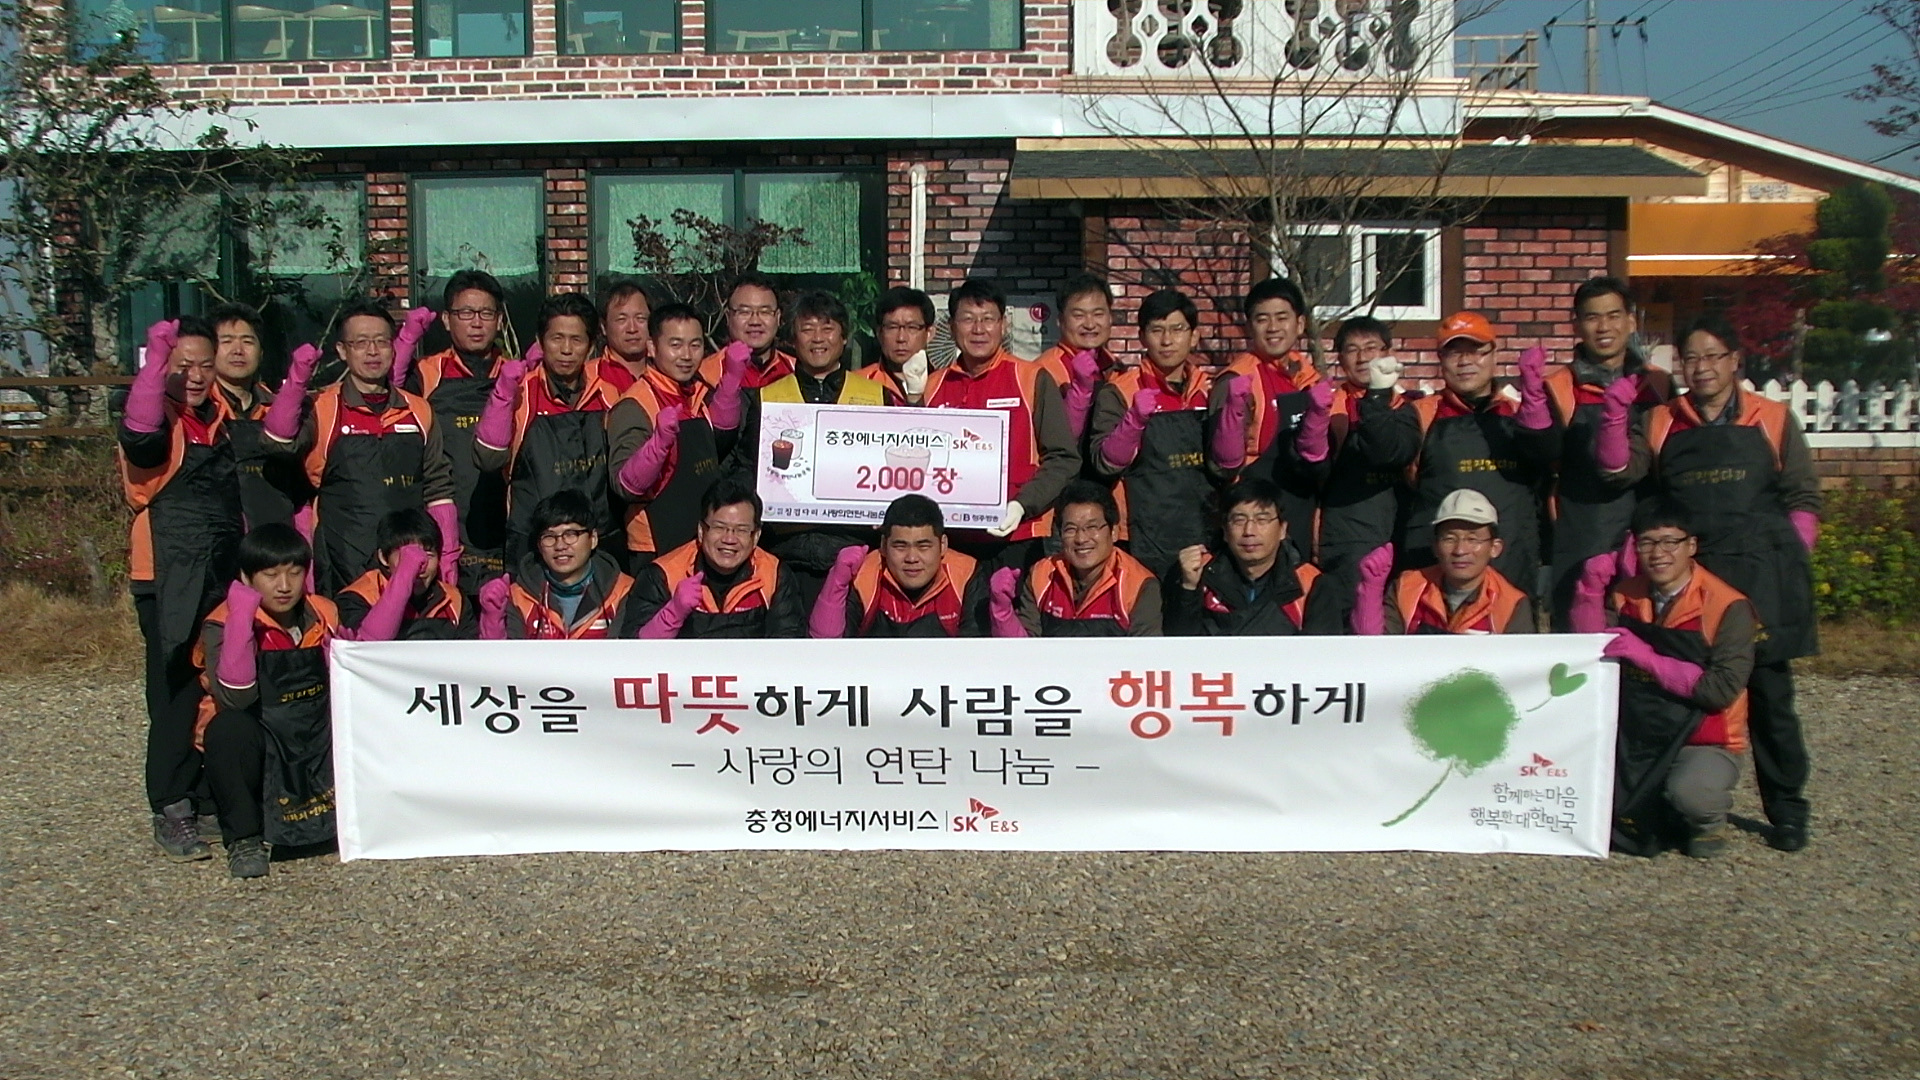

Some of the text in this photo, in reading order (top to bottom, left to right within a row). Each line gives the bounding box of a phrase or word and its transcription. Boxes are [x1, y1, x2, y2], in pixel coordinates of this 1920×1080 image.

[825, 430, 944, 448] 충청에너지서비스
[952, 437, 994, 452] SK E&S
[856, 465, 959, 495] 2,000 장
[406, 670, 1366, 739] 세상을 따뜻하게 사람을 행복하게
[717, 746, 1055, 786] 사랑의 연탄 나눔
[1520, 765, 1568, 778] SK E&S
[746, 809, 939, 834] 충청에너지서비스
[953, 815, 1019, 833] SK E&S
